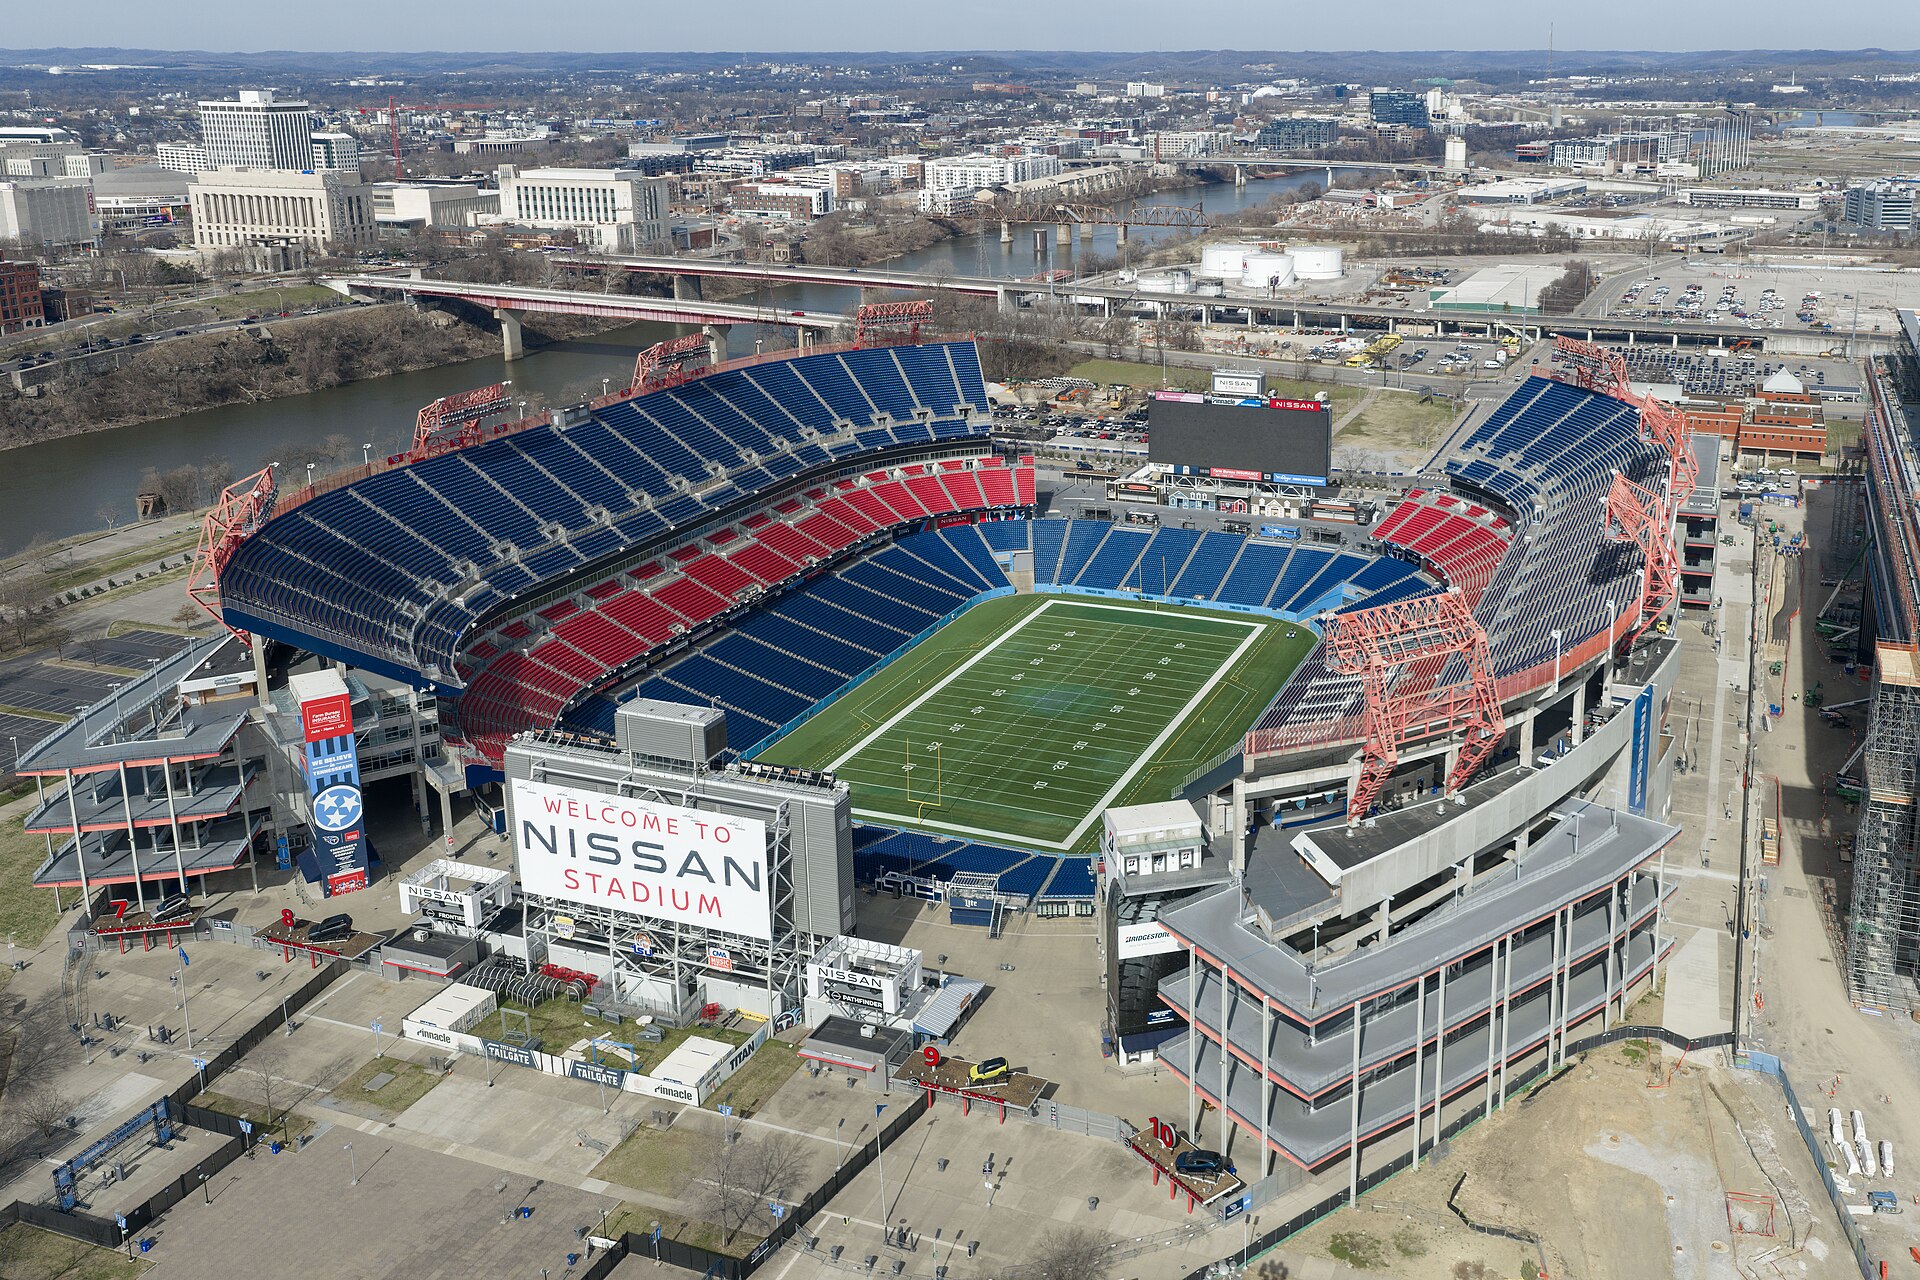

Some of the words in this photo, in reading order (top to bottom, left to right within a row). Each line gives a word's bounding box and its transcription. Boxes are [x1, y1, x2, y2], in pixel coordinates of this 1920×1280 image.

[1219, 379, 1252, 387] NISSAN
[1212, 397, 1236, 405] Pinnacle
[1276, 401, 1315, 410] NISSAN
[941, 515, 967, 524] NISSAN
[970, 705, 985, 715] 40
[1109, 704, 1124, 714] 50
[312, 713, 341, 723] INSURANCE
[949, 722, 965, 733] 30
[1091, 722, 1107, 732] 40
[926, 741, 942, 752] 20
[1072, 740, 1088, 751] 30
[311, 759, 323, 767] WE
[324, 753, 352, 764] BELIEVE
[1052, 760, 1069, 771] 20
[312, 764, 354, 777] TENNESSEANS
[901, 763, 917, 772] 10
[1032, 780, 1048, 790] 10
[543, 796, 679, 835] WELCOME
[694, 822, 731, 843] TO
[522, 819, 761, 892] NISSAN
[408, 886, 462, 903] NISSAN
[564, 868, 722, 918] STADIUM
[964, 899, 978, 907] Lite
[109, 899, 128, 919] 7
[281, 908, 295, 927] 8
[712, 950, 727, 958] CMA
[711, 957, 729, 966] MUSIC
[818, 967, 882, 988] NISSAN
[842, 994, 883, 1008] PATHFINDER
[417, 1028, 451, 1044] Pinnacle
[488, 1047, 530, 1065] TAILGATE
[923, 1046, 941, 1067] 9
[576, 1067, 618, 1086] TAILGATE
[654, 1084, 693, 1101] Pinnacle
[1148, 1116, 1174, 1148] 10
